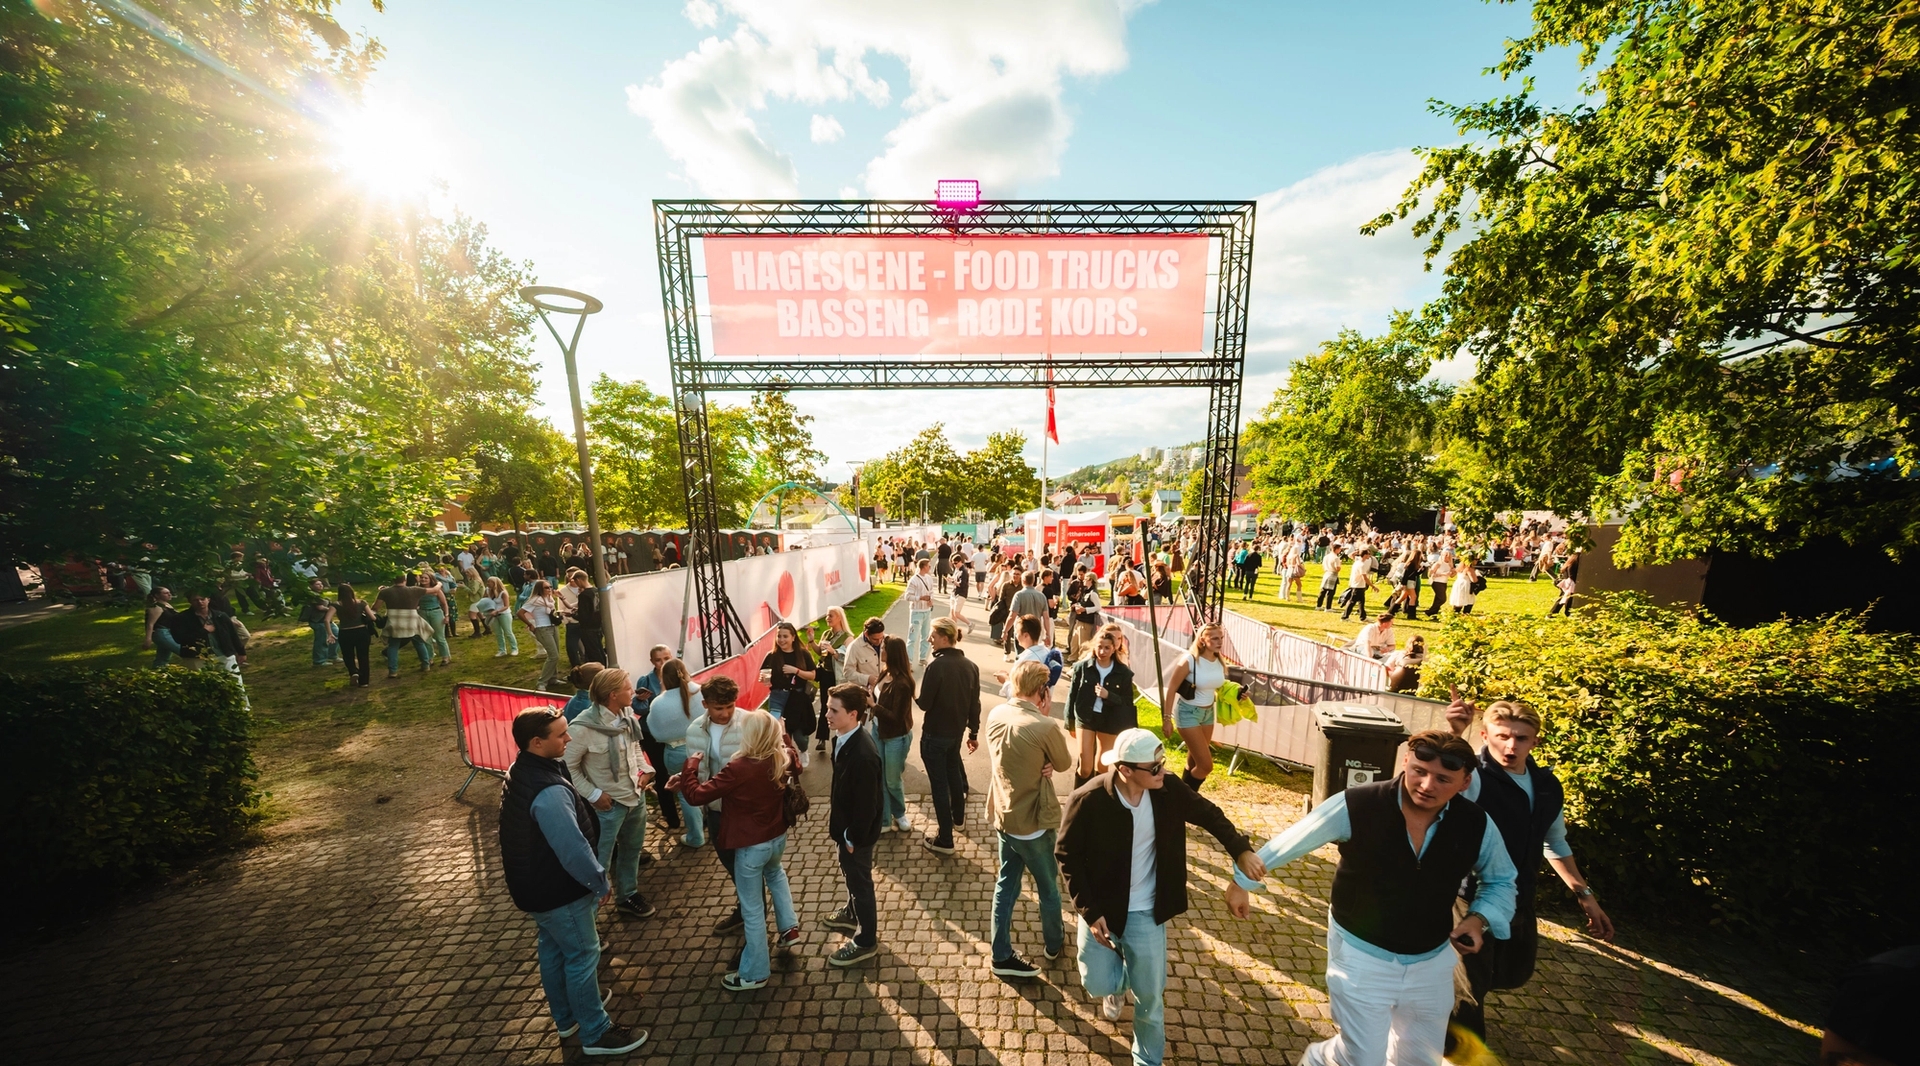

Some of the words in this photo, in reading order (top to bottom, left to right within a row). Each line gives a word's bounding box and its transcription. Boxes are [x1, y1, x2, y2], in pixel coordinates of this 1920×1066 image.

[731, 250, 926, 291] HAGESCENE
[954, 250, 1040, 291] FOOD
[1047, 249, 1180, 290] TRUCKS
[776, 298, 929, 338] BASSENG
[957, 297, 1043, 337] RØDE
[1051, 297, 1148, 337] KORS.
